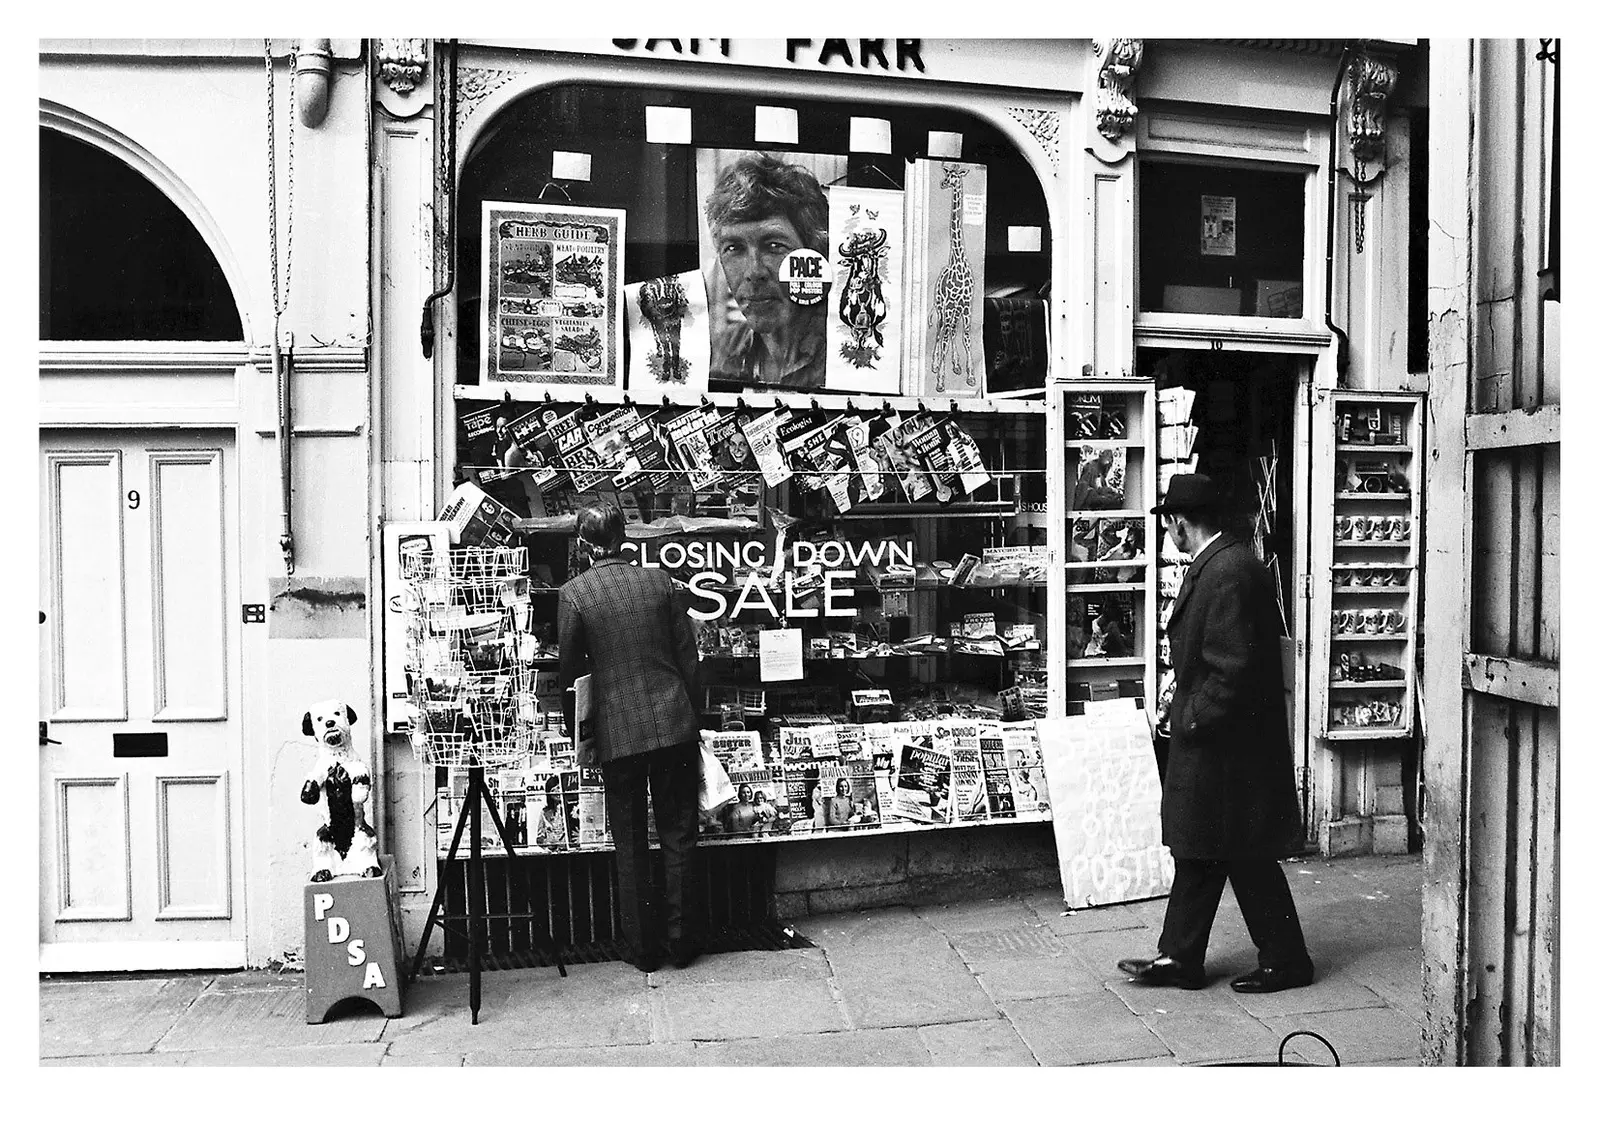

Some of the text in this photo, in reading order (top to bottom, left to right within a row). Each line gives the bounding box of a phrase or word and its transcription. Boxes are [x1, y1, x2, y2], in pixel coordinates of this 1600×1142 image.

[786, 38, 925, 73] FARR
[515, 226, 592, 241] HERB GUIDE
[789, 256, 822, 278] PACE
[1211, 340, 1223, 351] 10
[466, 416, 492, 431] Tape
[587, 405, 634, 433] Competition
[780, 417, 813, 437] Ecologist
[559, 427, 585, 450] CAR
[807, 432, 826, 449] SHE
[911, 428, 940, 448] Woman
[920, 436, 942, 454] Home
[127, 489, 141, 510] 9
[1028, 502, 1047, 513] HOUS
[620, 541, 914, 569] CLOSING DOWN
[686, 570, 858, 621] SALE
[784, 760, 840, 772] woman
[910, 748, 951, 767] popular
